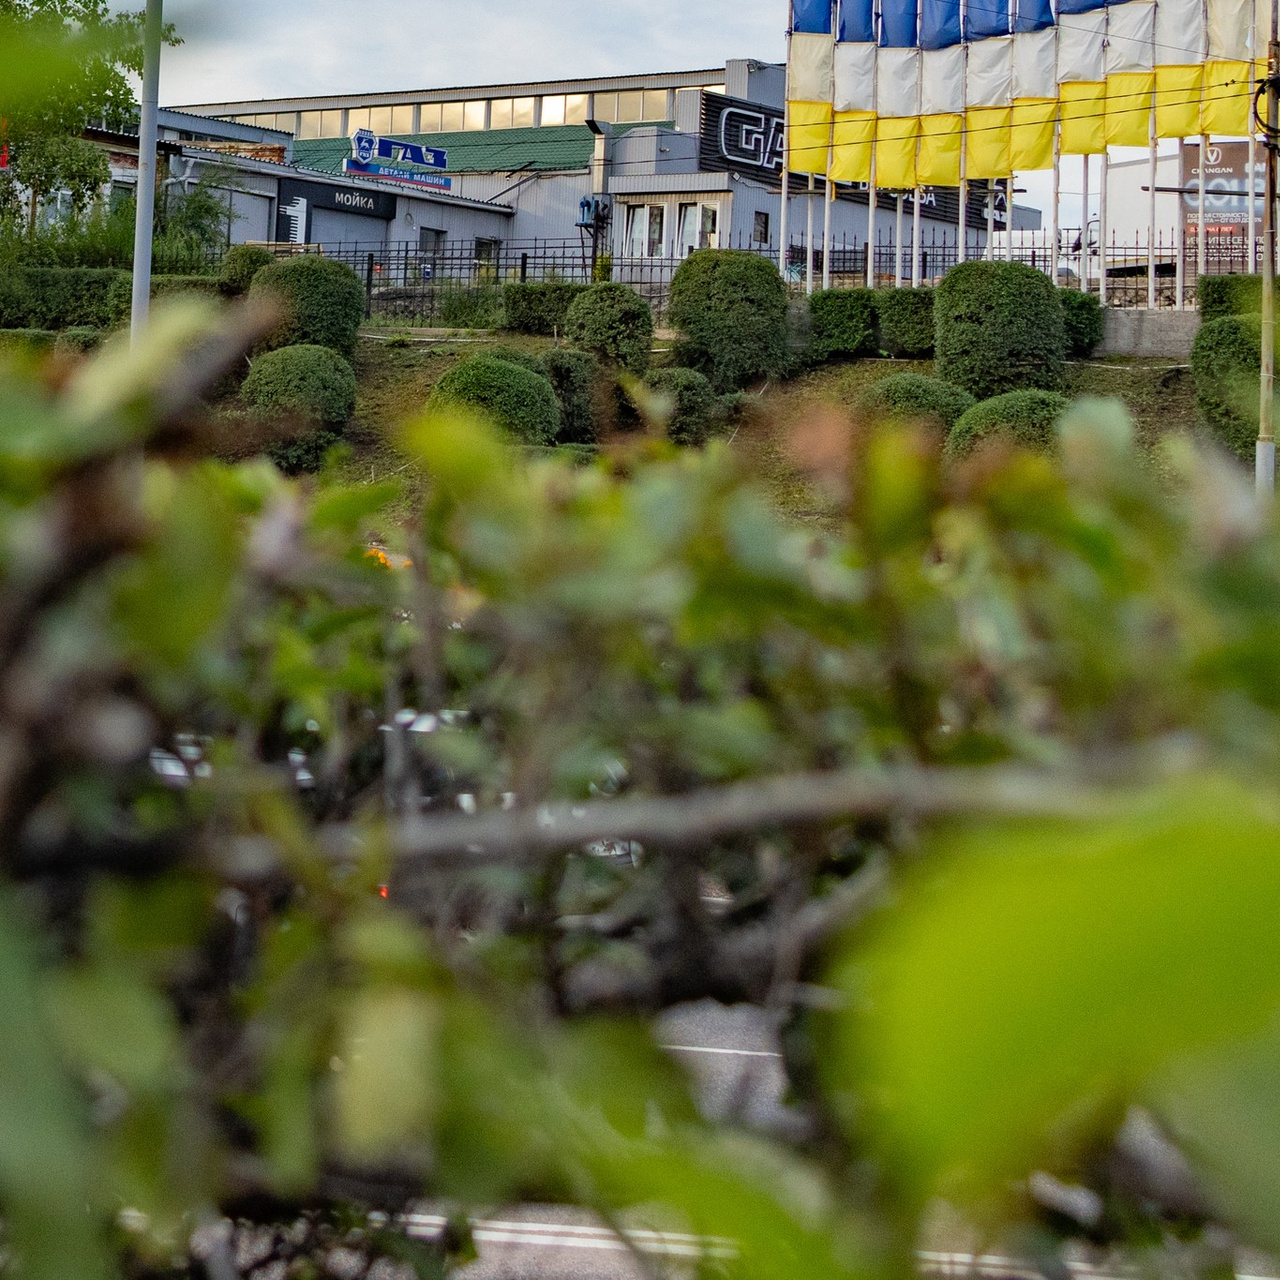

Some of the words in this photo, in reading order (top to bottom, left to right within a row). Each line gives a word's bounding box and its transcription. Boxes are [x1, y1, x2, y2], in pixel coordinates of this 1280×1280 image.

[378, 137, 448, 169] ГАЗ
[379, 167, 410, 180] ДЕТАЛИ
[413, 174, 445, 186] МАШИН
[335, 192, 374, 210] МОЙКА
